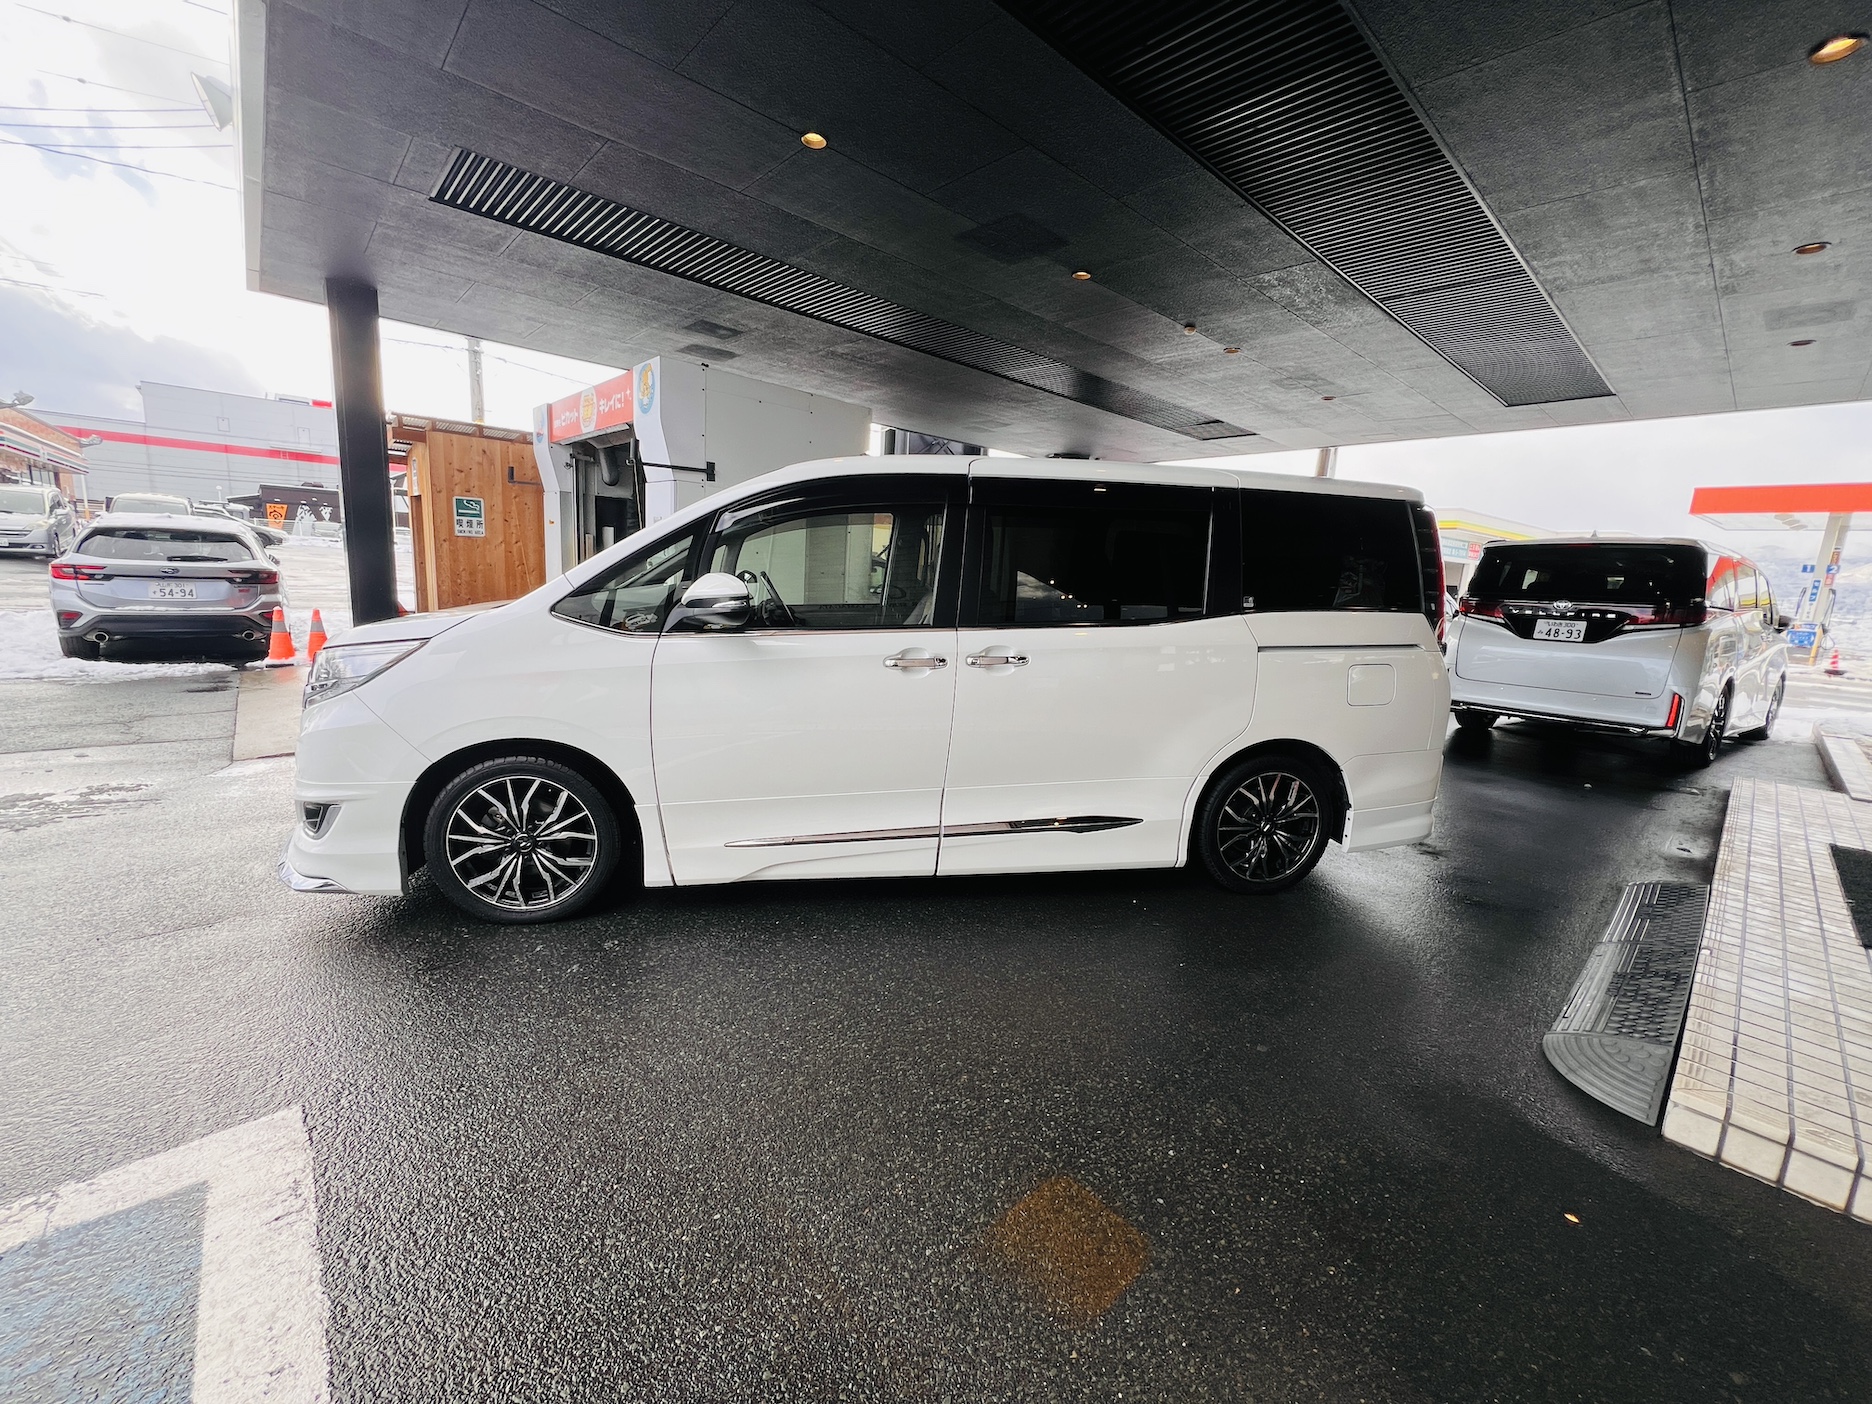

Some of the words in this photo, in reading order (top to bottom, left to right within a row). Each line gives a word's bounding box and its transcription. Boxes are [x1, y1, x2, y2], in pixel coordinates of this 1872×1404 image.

[599, 392, 625, 414] キレイに!
[456, 519, 483, 529] 喫煙所
[1829, 565, 1839, 573] 2
[159, 588, 194, 597] 54-94
[1509, 606, 1616, 618] VELLFIRE
[1545, 628, 1582, 639] 48-93
